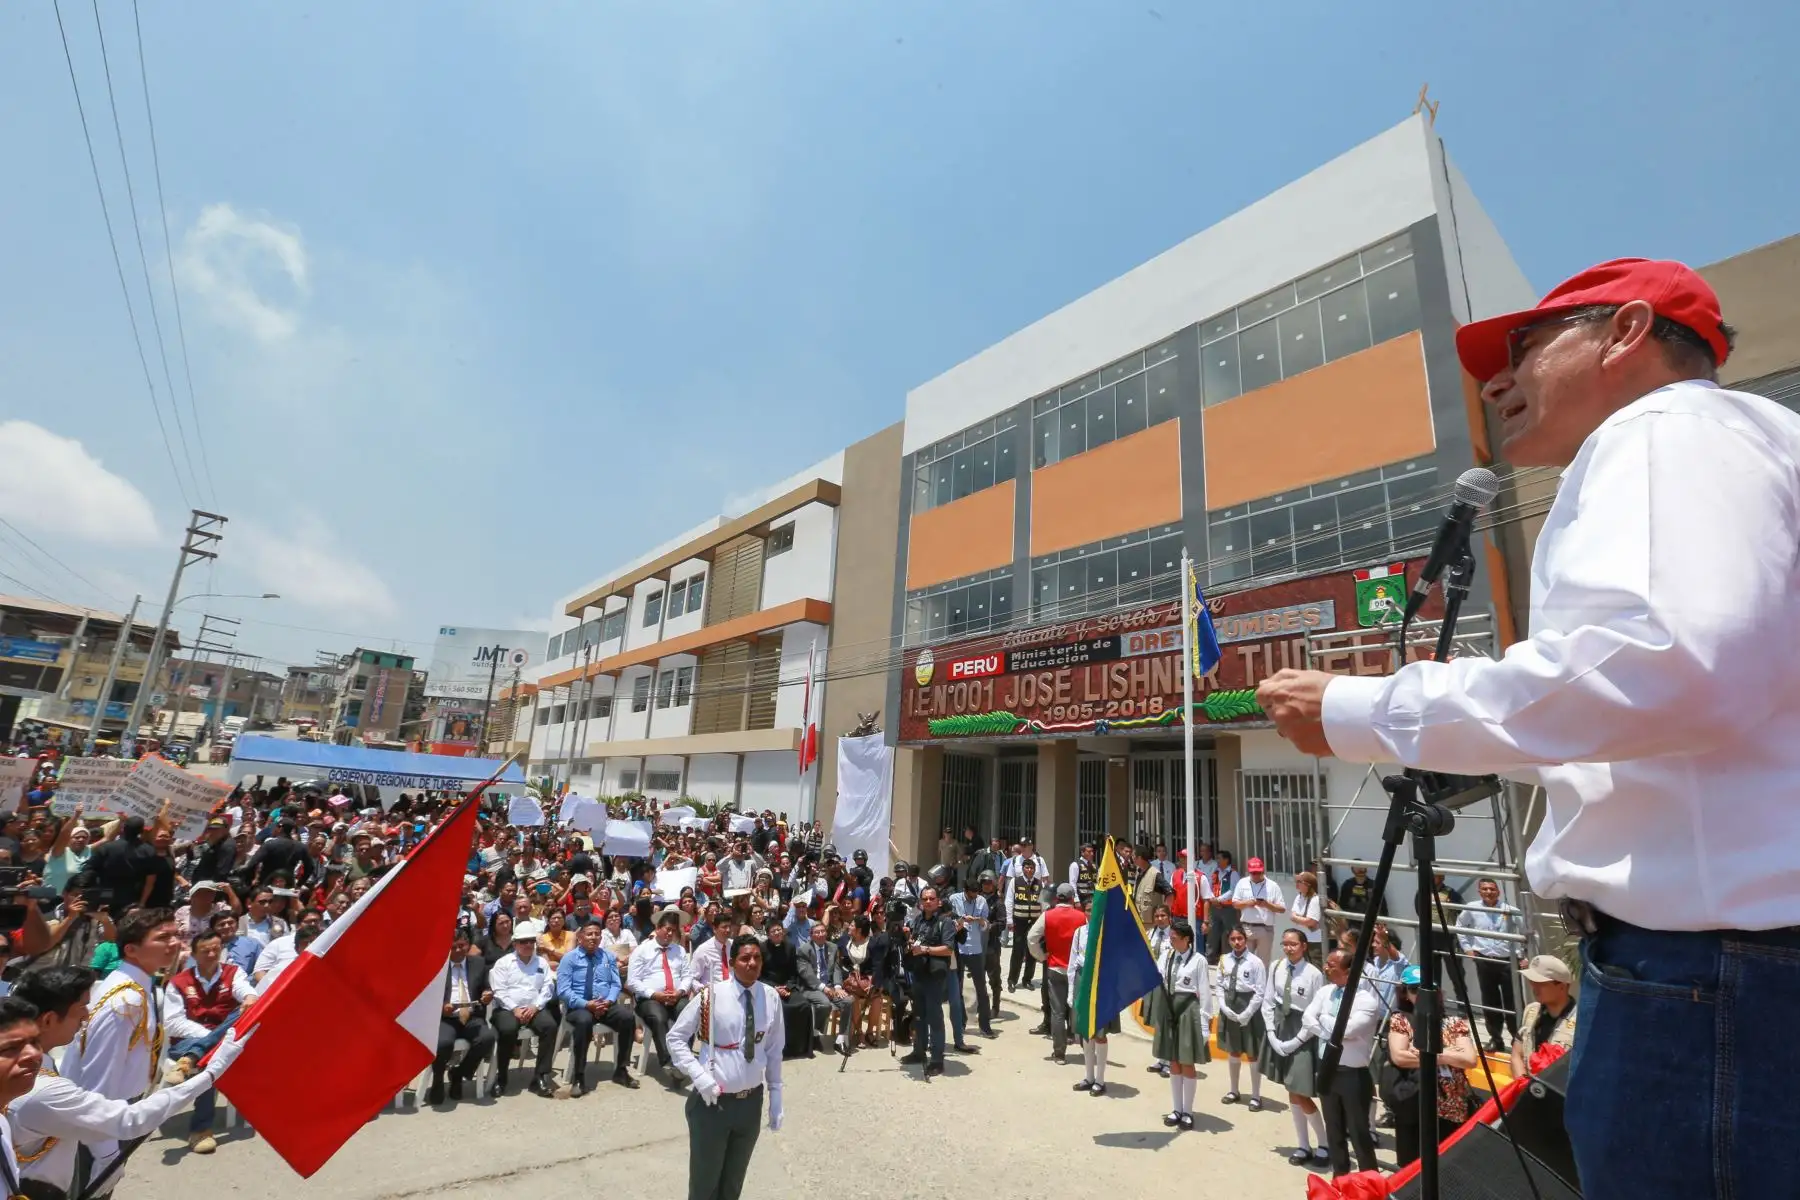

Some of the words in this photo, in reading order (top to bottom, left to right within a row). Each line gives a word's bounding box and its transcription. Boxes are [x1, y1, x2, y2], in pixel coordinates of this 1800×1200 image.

[1215, 607, 1321, 639] UMBES
[472, 645, 509, 662] JMT
[1011, 643, 1088, 661] Ministerio
[1093, 640, 1111, 649] de
[952, 656, 998, 677] PERÚ
[1011, 652, 1089, 671] Educación
[1005, 665, 1072, 709] JOSÉ
[1043, 697, 1164, 722] 1905-2018
[328, 769, 373, 785] GOBIERNO
[375, 776, 416, 789] REGIONAL
[419, 779, 430, 789] DE
[432, 779, 463, 791] TUMBES
